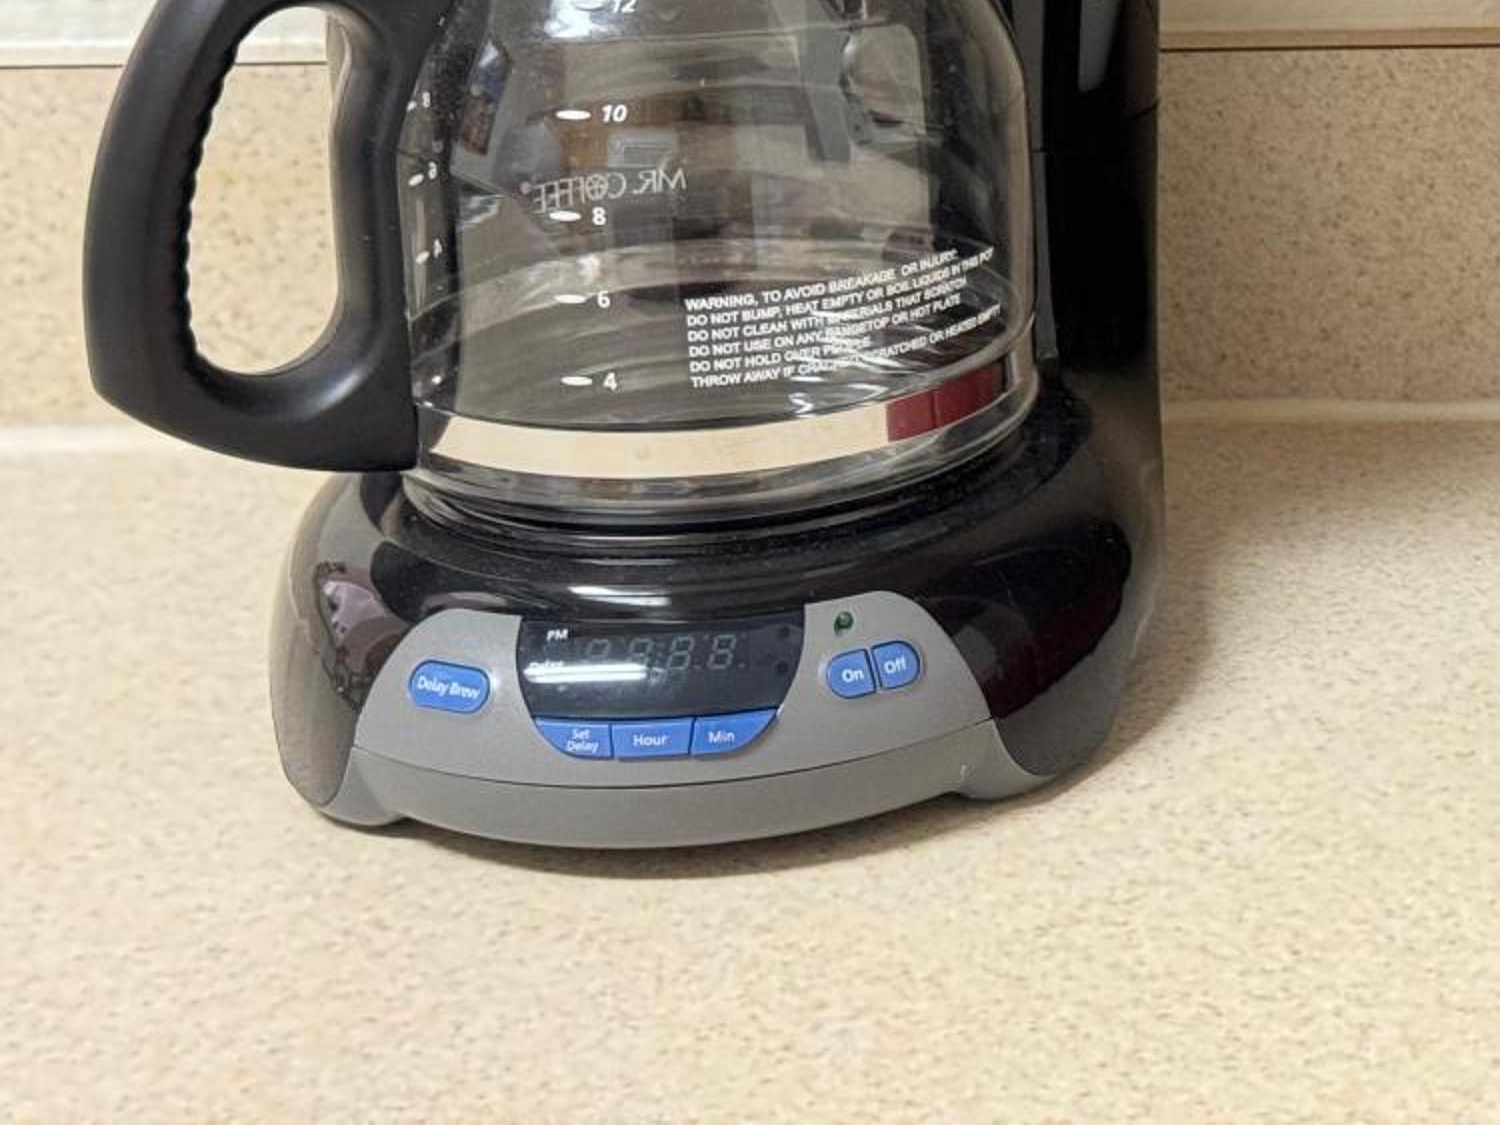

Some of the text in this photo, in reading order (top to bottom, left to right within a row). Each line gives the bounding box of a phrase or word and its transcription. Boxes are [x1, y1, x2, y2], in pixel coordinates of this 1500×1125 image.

[602, 104, 628, 123] 10
[592, 206, 607, 225] 8
[687, 315, 708, 327] DO
[710, 311, 739, 324] NOT
[785, 300, 818, 316] HEAT
[821, 292, 864, 310] EMPTY
[866, 287, 884, 300] OR
[951, 262, 961, 276] IN
[980, 246, 994, 264] POT
[761, 290, 781, 303] TO
[784, 283, 826, 299] AVOID
[902, 262, 918, 276] OR
[597, 290, 611, 308] 6
[688, 330, 708, 342] DO
[711, 326, 740, 340] NOT
[742, 320, 787, 336] CLEAN
[790, 315, 824, 330] WITH
[895, 292, 922, 308] THAT
[689, 345, 709, 357] DO
[713, 341, 740, 355] NOT
[743, 338, 771, 352] USE
[774, 335, 794, 347] ON
[891, 311, 908, 325] OR
[910, 303, 930, 321] HOT
[932, 293, 960, 313] PLATE
[690, 372, 741, 388] THROW
[744, 368, 780, 382] AWAY
[783, 365, 795, 378] IF
[929, 330, 944, 344] OR
[690, 360, 710, 372] DO
[713, 357, 742, 369] NOT
[745, 352, 781, 367] HOLD
[603, 372, 618, 391] 4
[547, 629, 569, 641] PM
[884, 656, 906, 674] Off
[842, 668, 865, 683] On
[417, 675, 480, 699] Delay Brew
[572, 729, 590, 740] Set
[633, 734, 669, 746] Hour
[708, 730, 735, 743] Min
[566, 740, 598, 754] Delay
